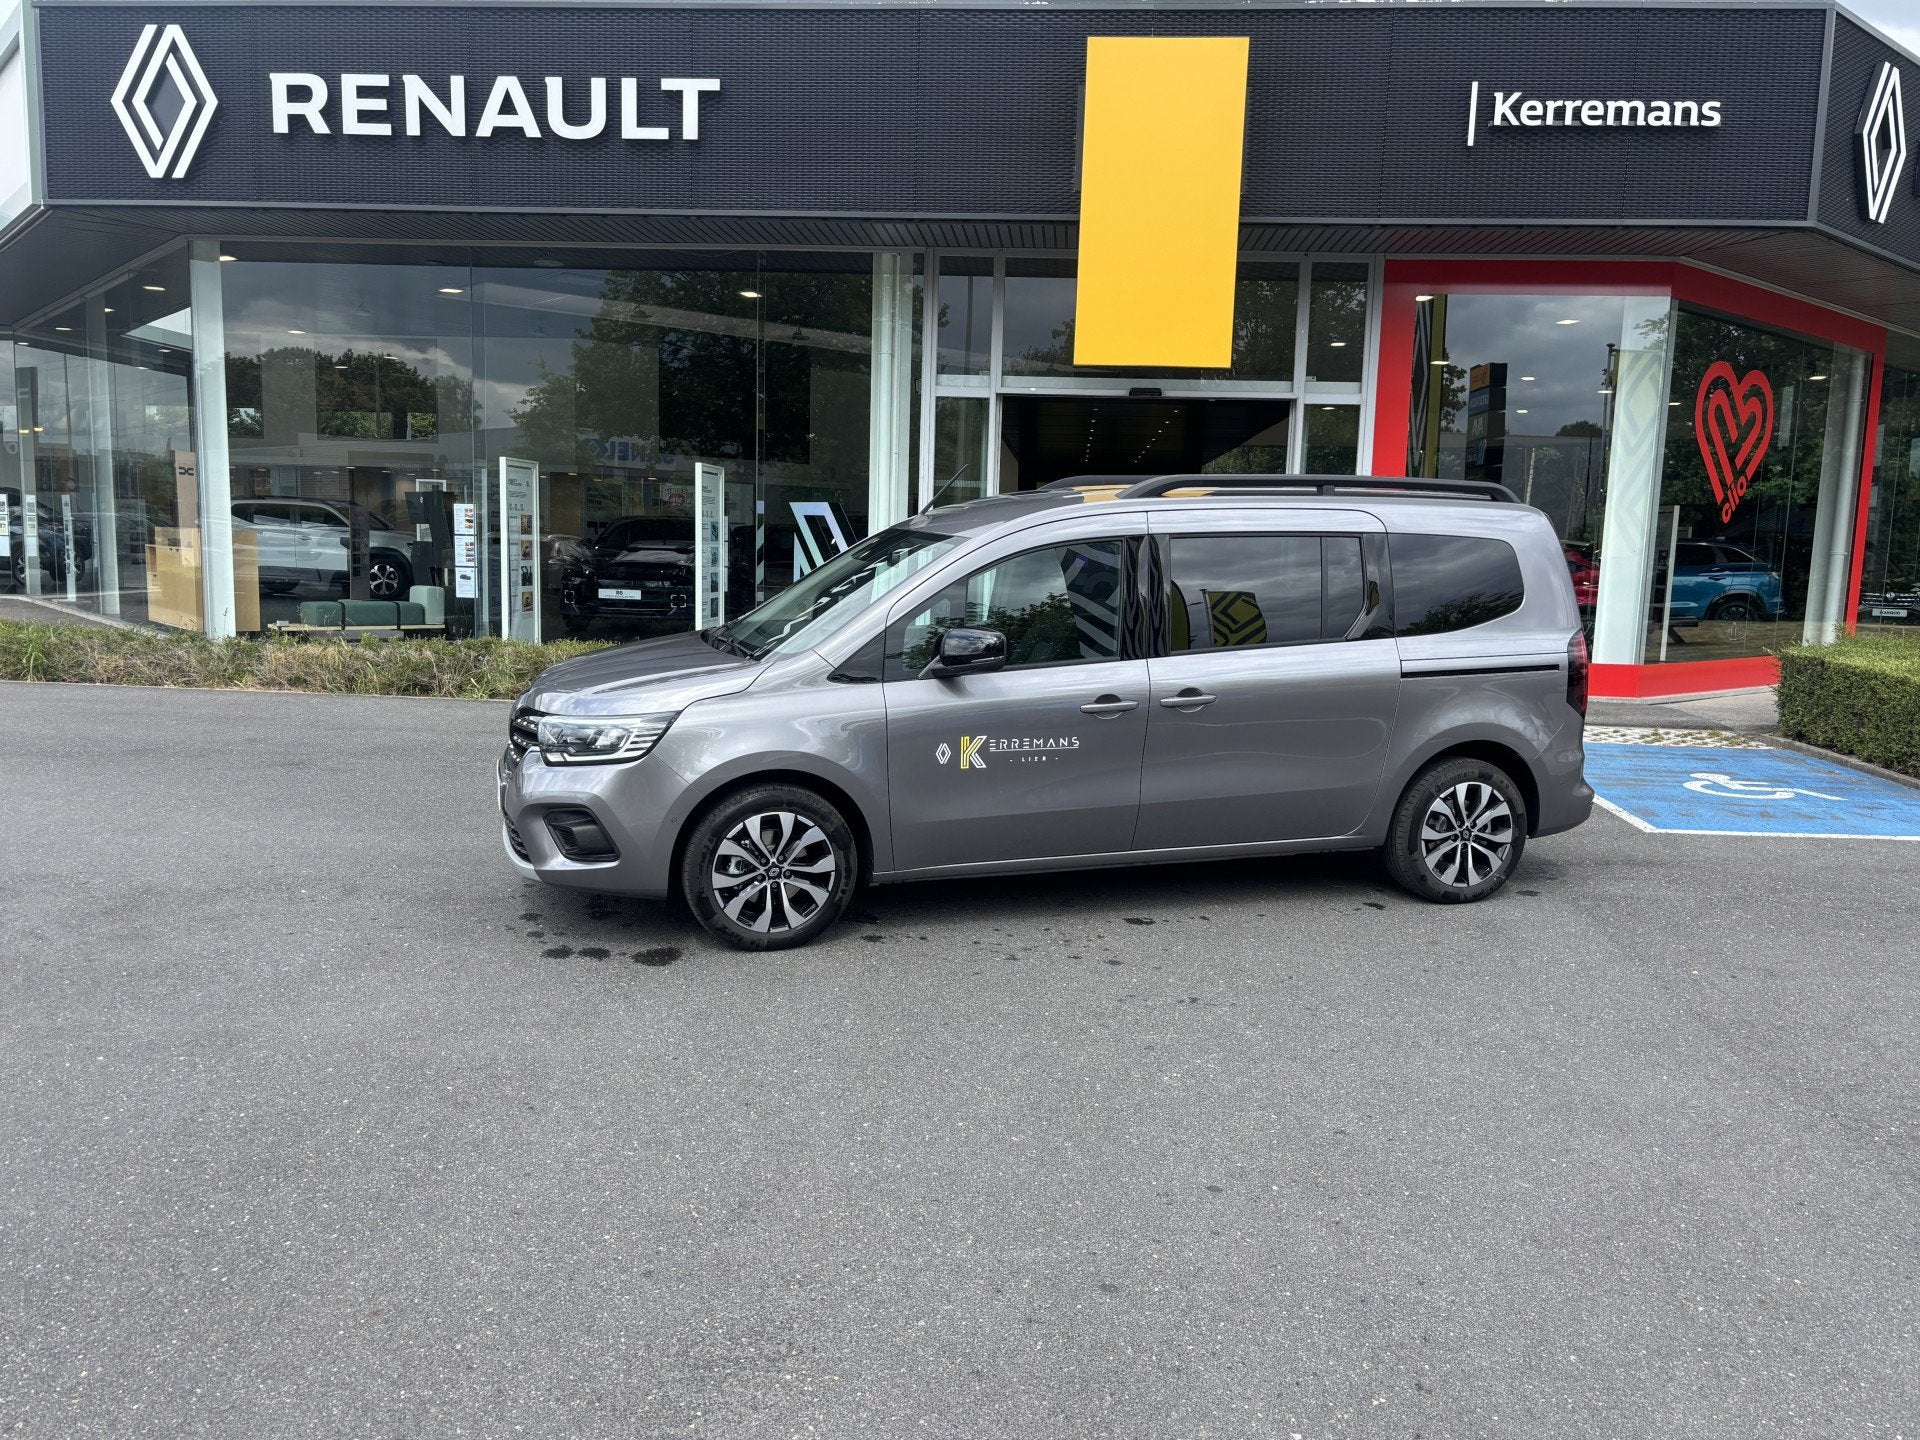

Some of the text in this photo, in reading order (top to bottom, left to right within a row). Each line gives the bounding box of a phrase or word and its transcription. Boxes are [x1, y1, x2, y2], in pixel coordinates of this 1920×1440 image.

[268, 72, 722, 141] RENAULT
[1493, 91, 1722, 127] Kerremans
[1721, 475, 1748, 524] clio
